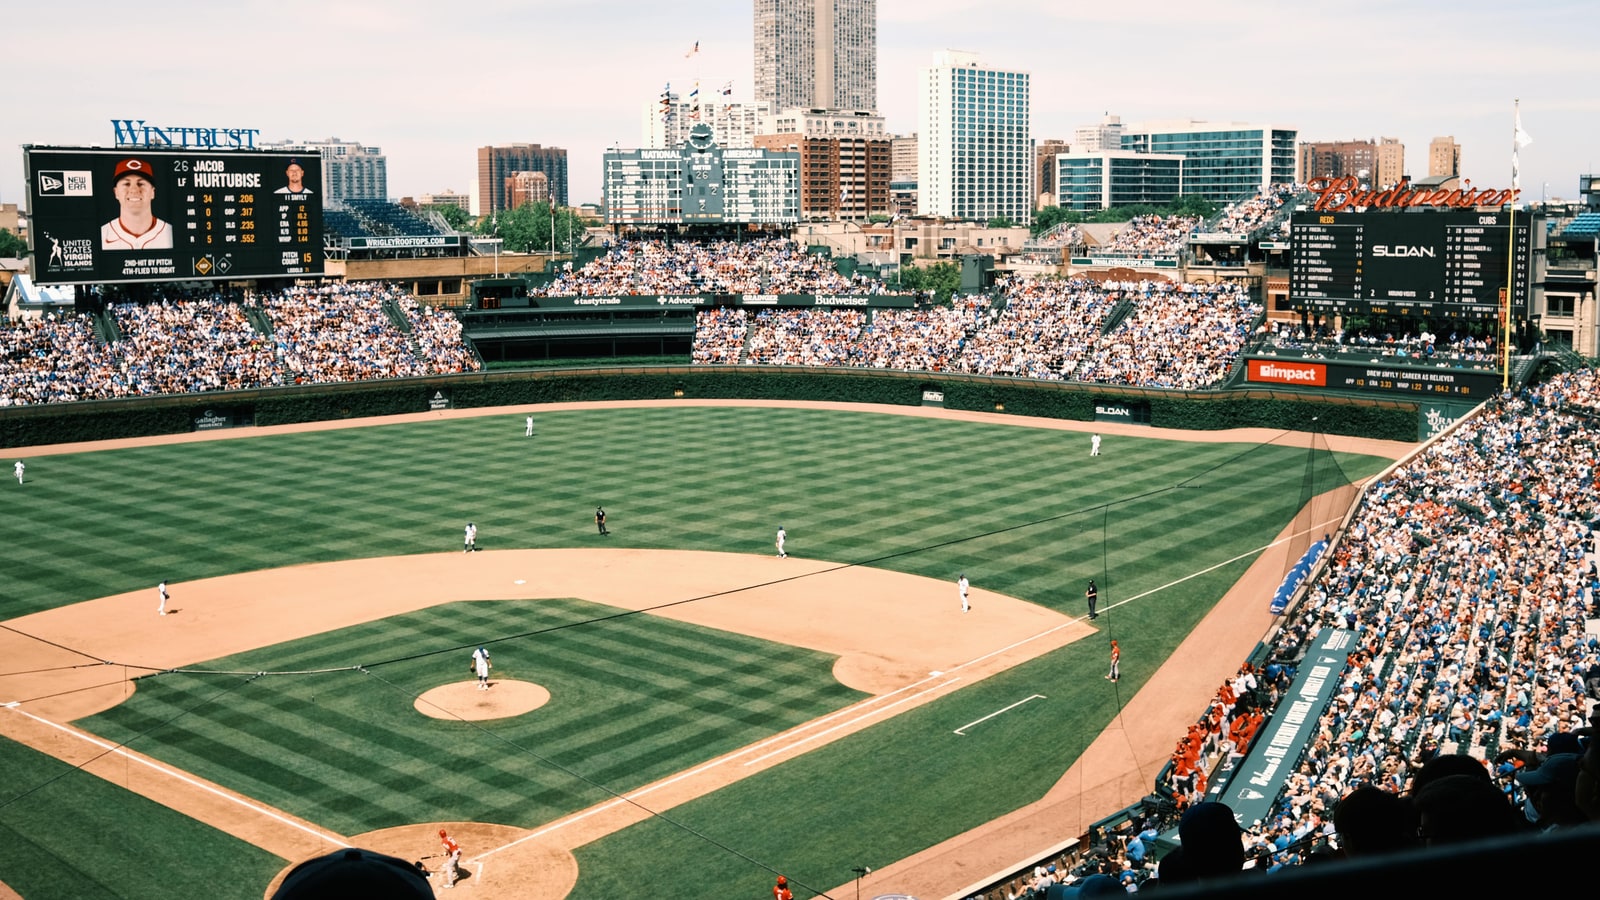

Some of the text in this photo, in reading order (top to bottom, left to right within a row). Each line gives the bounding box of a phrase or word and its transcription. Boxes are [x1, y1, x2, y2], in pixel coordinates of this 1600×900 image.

[110, 119, 260, 149] WINTRUST
[641, 150, 681, 159] NATIONAL
[722, 149, 763, 158] AMERICAN
[174, 160, 224, 172] 26 JACOB
[695, 170, 709, 180] 26
[178, 173, 261, 187] LF HURTUBISE
[68, 183, 87, 191] ERA
[711, 186, 718, 196] 2
[203, 195, 212, 203] 34
[239, 194, 253, 203] .206
[1307, 176, 1521, 212] Budweiser
[206, 208, 211, 216] 0
[240, 208, 253, 216] .317
[1320, 216, 1334, 224] REDS
[1479, 216, 1496, 224] CUBS
[207, 221, 211, 230] 3
[240, 221, 254, 229] .235
[207, 235, 212, 243] 5
[241, 234, 255, 243] .552
[366, 237, 446, 247] WRIGLEYROOFTOPS.COM
[63, 246, 93, 254] STATES
[1373, 245, 1435, 257] SLOAN
[304, 253, 311, 262] 15
[123, 259, 147, 267] 2ND-HIT
[156, 258, 173, 266] PITCH
[122, 267, 151, 275] 4TH-FLIED
[1430, 291, 1434, 299] 3
[580, 297, 621, 306] tastytrade
[668, 296, 705, 304] Advocate
[814, 295, 869, 305] Budweiser
[1270, 364, 1316, 381] impact
[1430, 374, 1454, 382] RELIEVER
[1095, 406, 1130, 416] SLOAN
[195, 416, 227, 424] Gallagher
